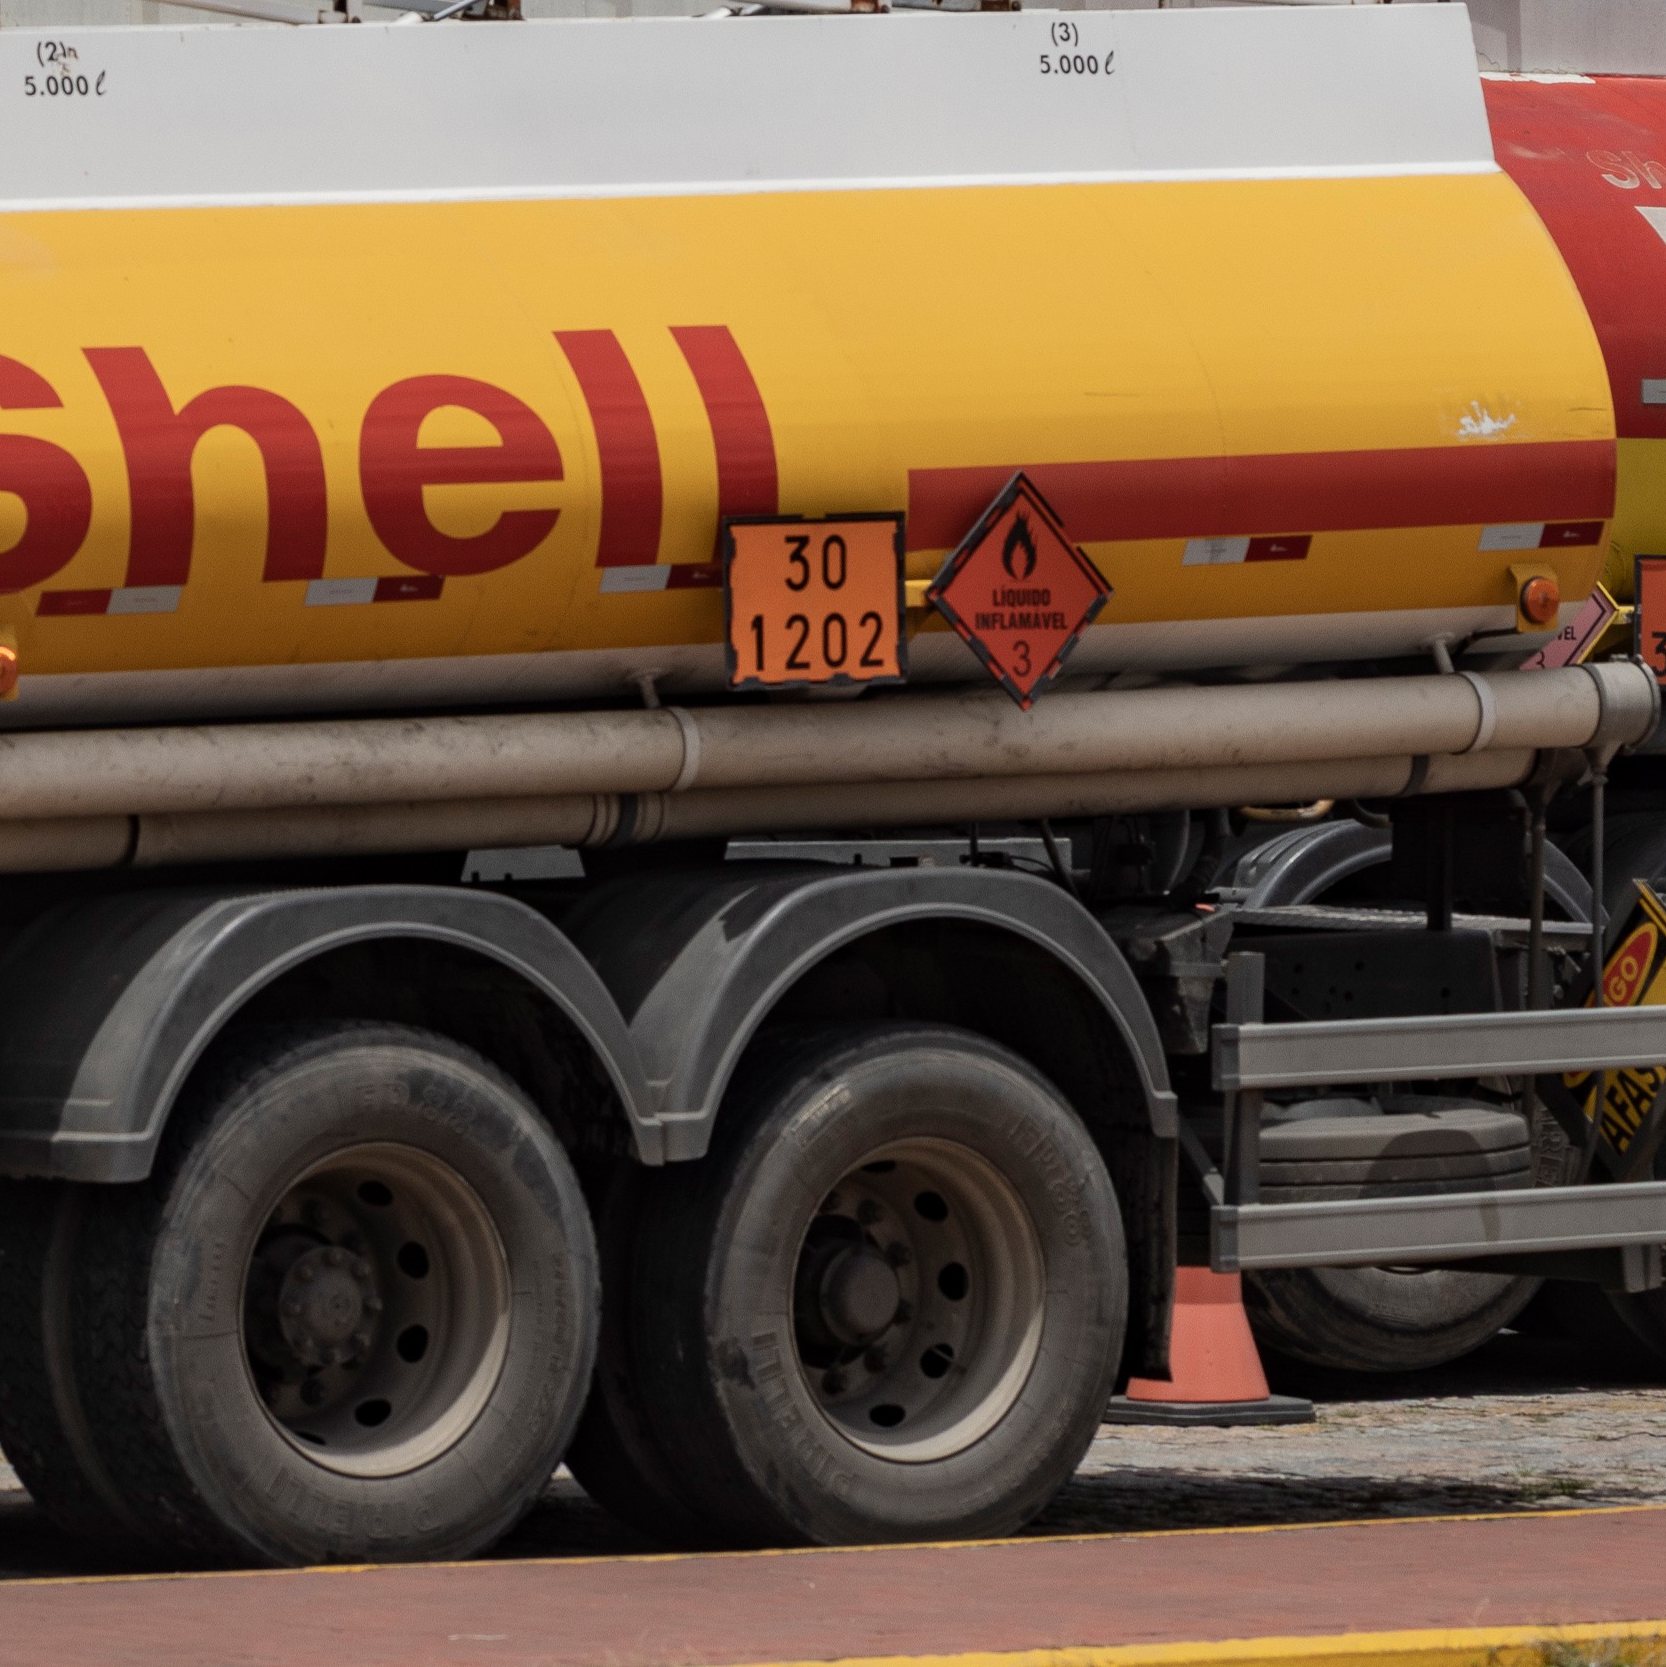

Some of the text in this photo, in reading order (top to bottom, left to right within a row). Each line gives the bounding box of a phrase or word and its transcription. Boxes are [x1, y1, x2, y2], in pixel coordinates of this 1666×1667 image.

[1051, 22, 1078, 47] (3)
[783, 533, 849, 592] 30
[749, 611, 886, 672] 1202
[1012, 640, 1032, 677] 3
